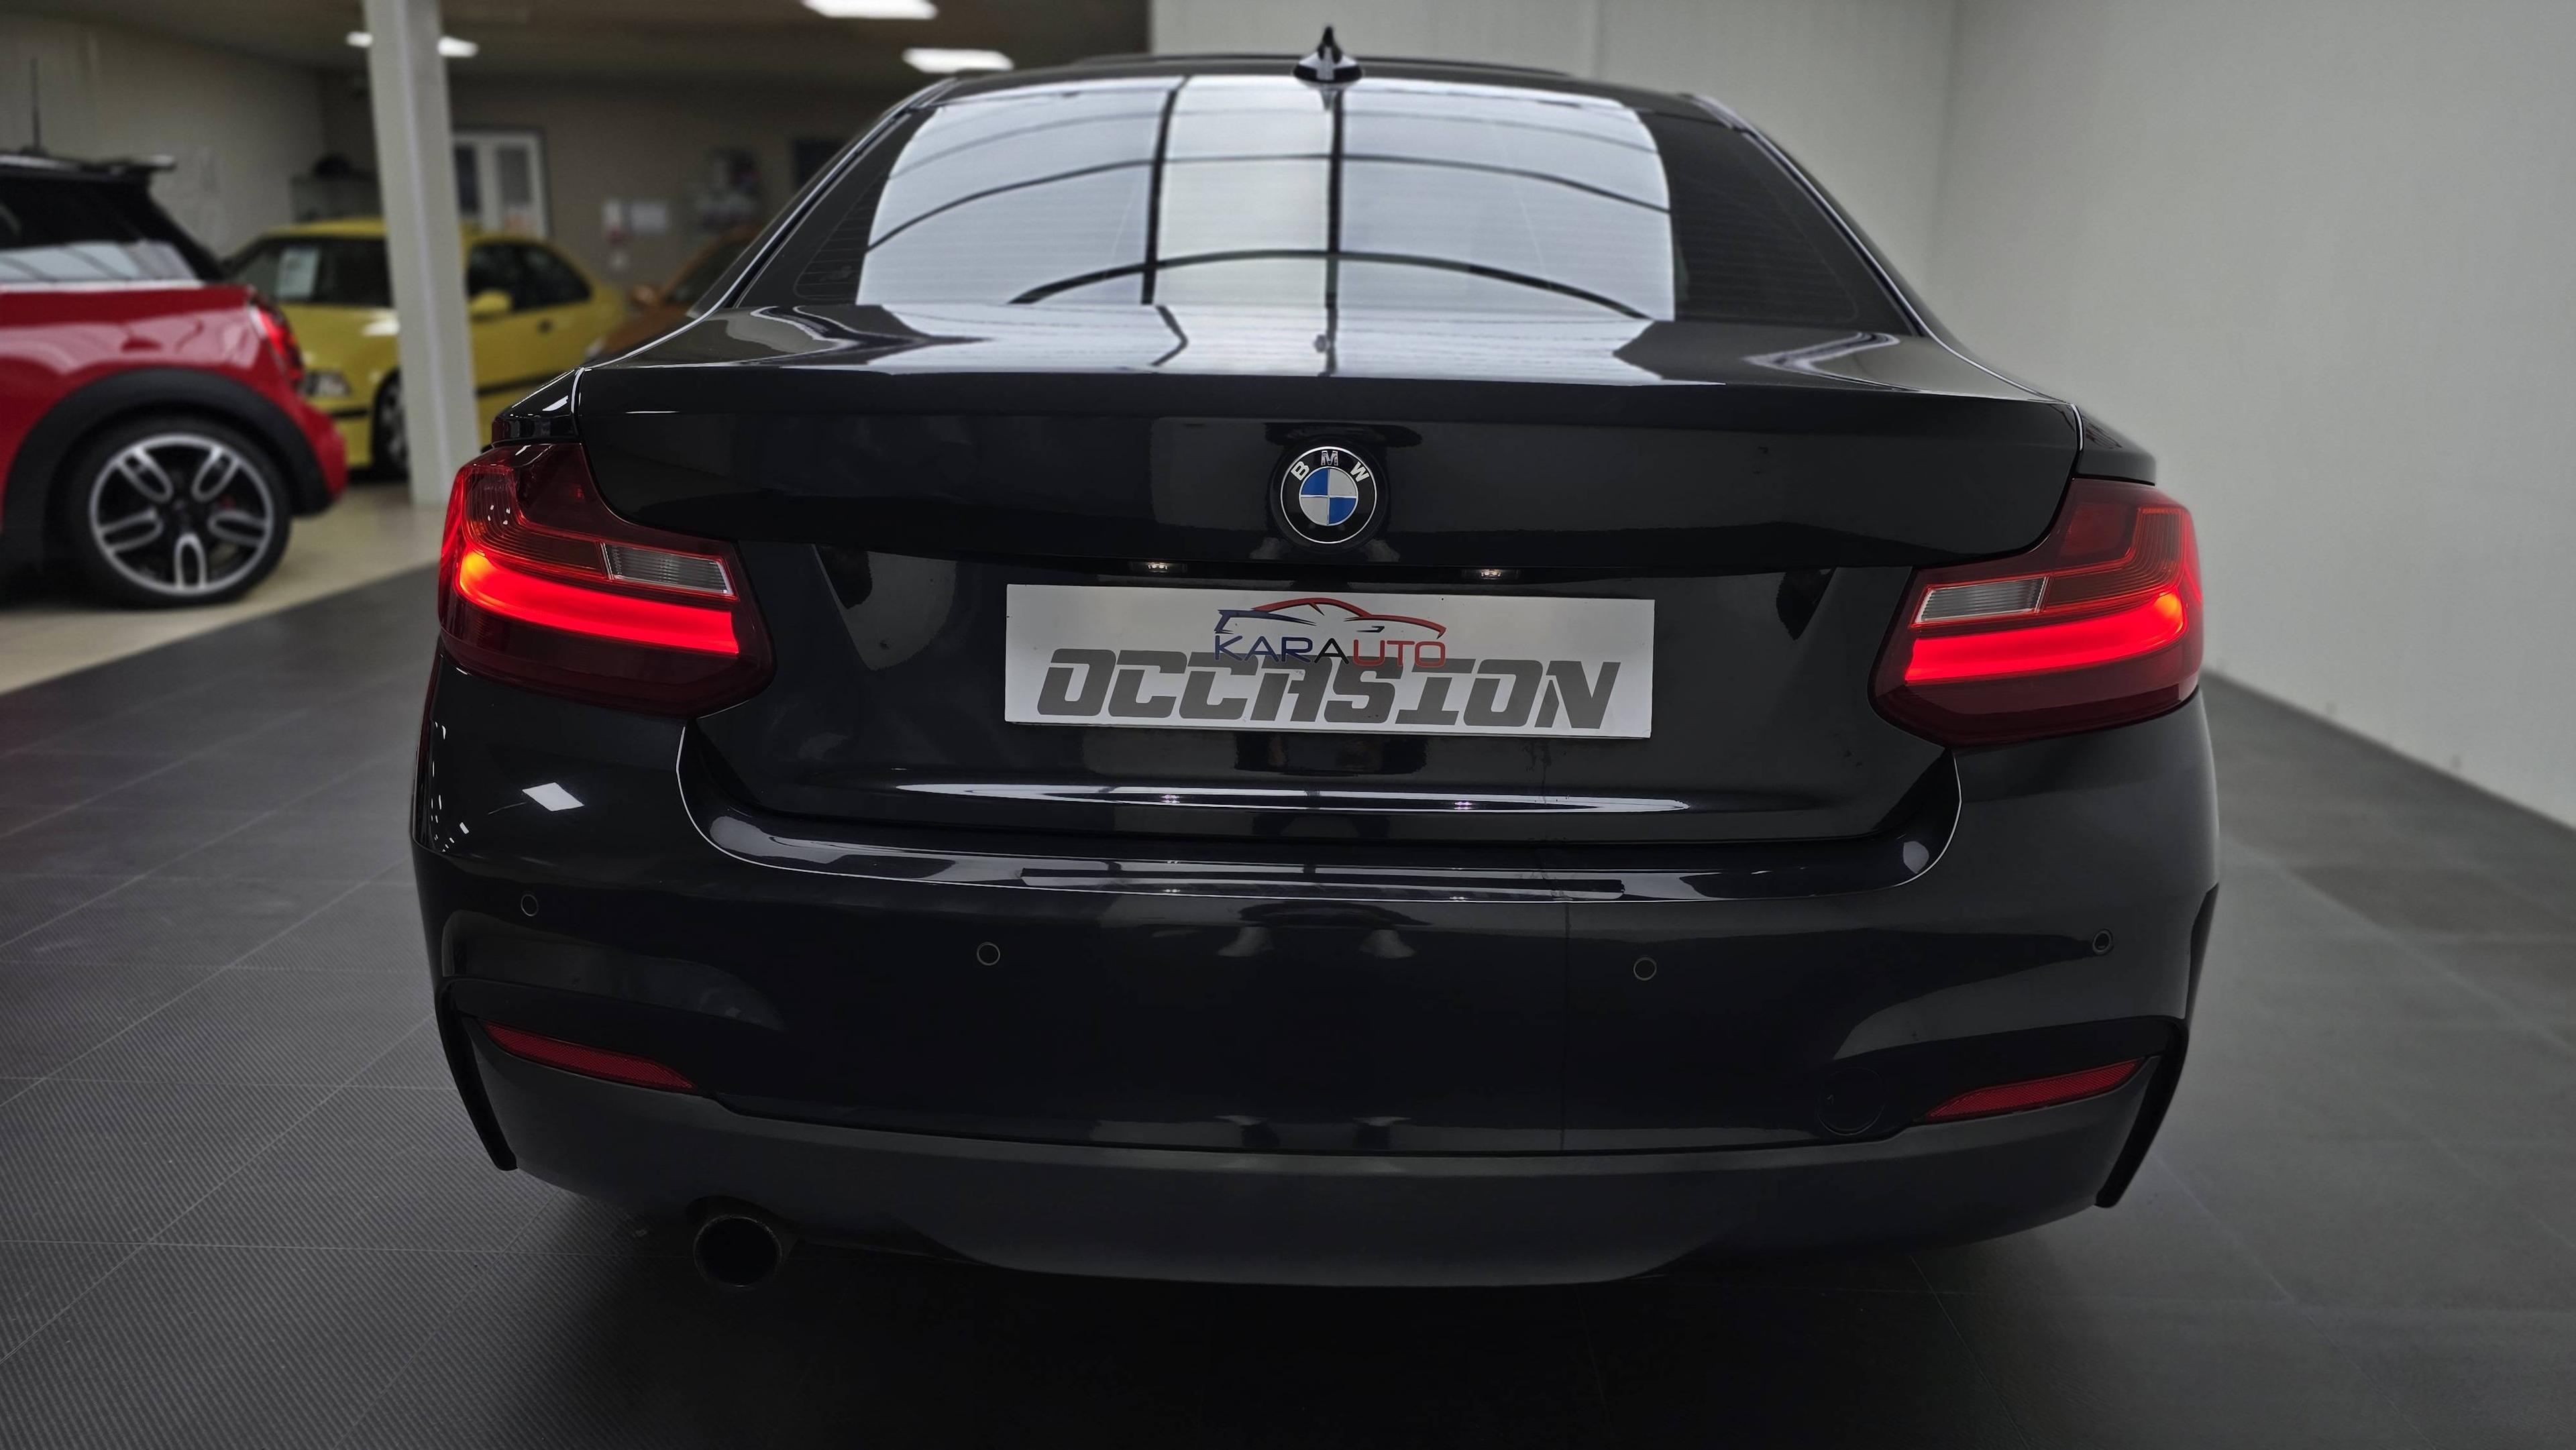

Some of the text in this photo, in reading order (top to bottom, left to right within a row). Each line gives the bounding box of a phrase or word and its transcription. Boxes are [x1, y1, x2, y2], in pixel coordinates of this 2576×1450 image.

[1290, 450, 1370, 482] BMW
[1214, 635, 1446, 668] KARAUTO
[1037, 648, 1621, 730] OCCASION
